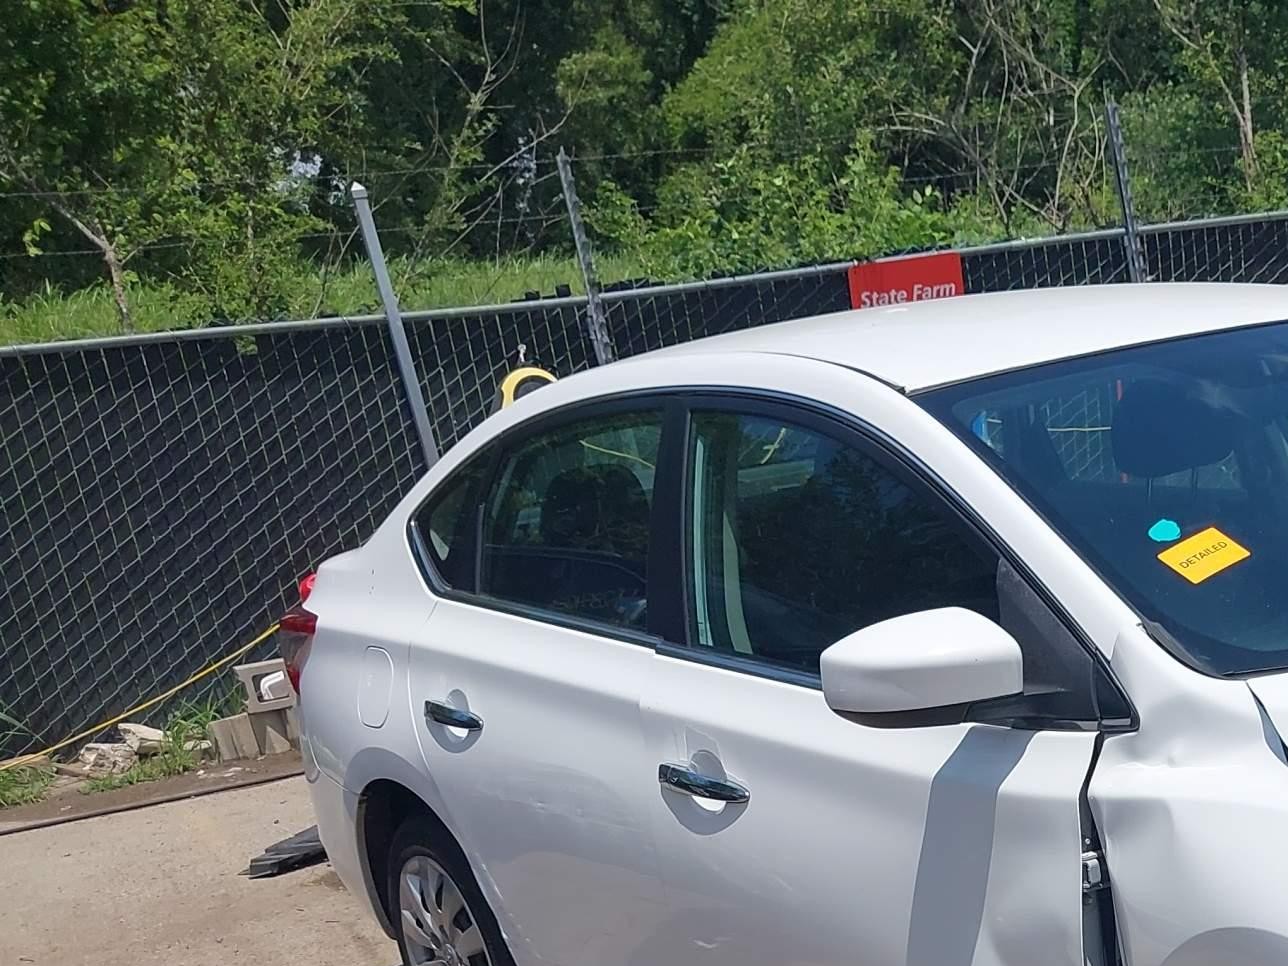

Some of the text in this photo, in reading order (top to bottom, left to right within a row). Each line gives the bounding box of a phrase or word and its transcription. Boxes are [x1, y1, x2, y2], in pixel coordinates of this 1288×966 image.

[860, 282, 956, 308] State Farm
[1179, 541, 1228, 569] DETAILED
